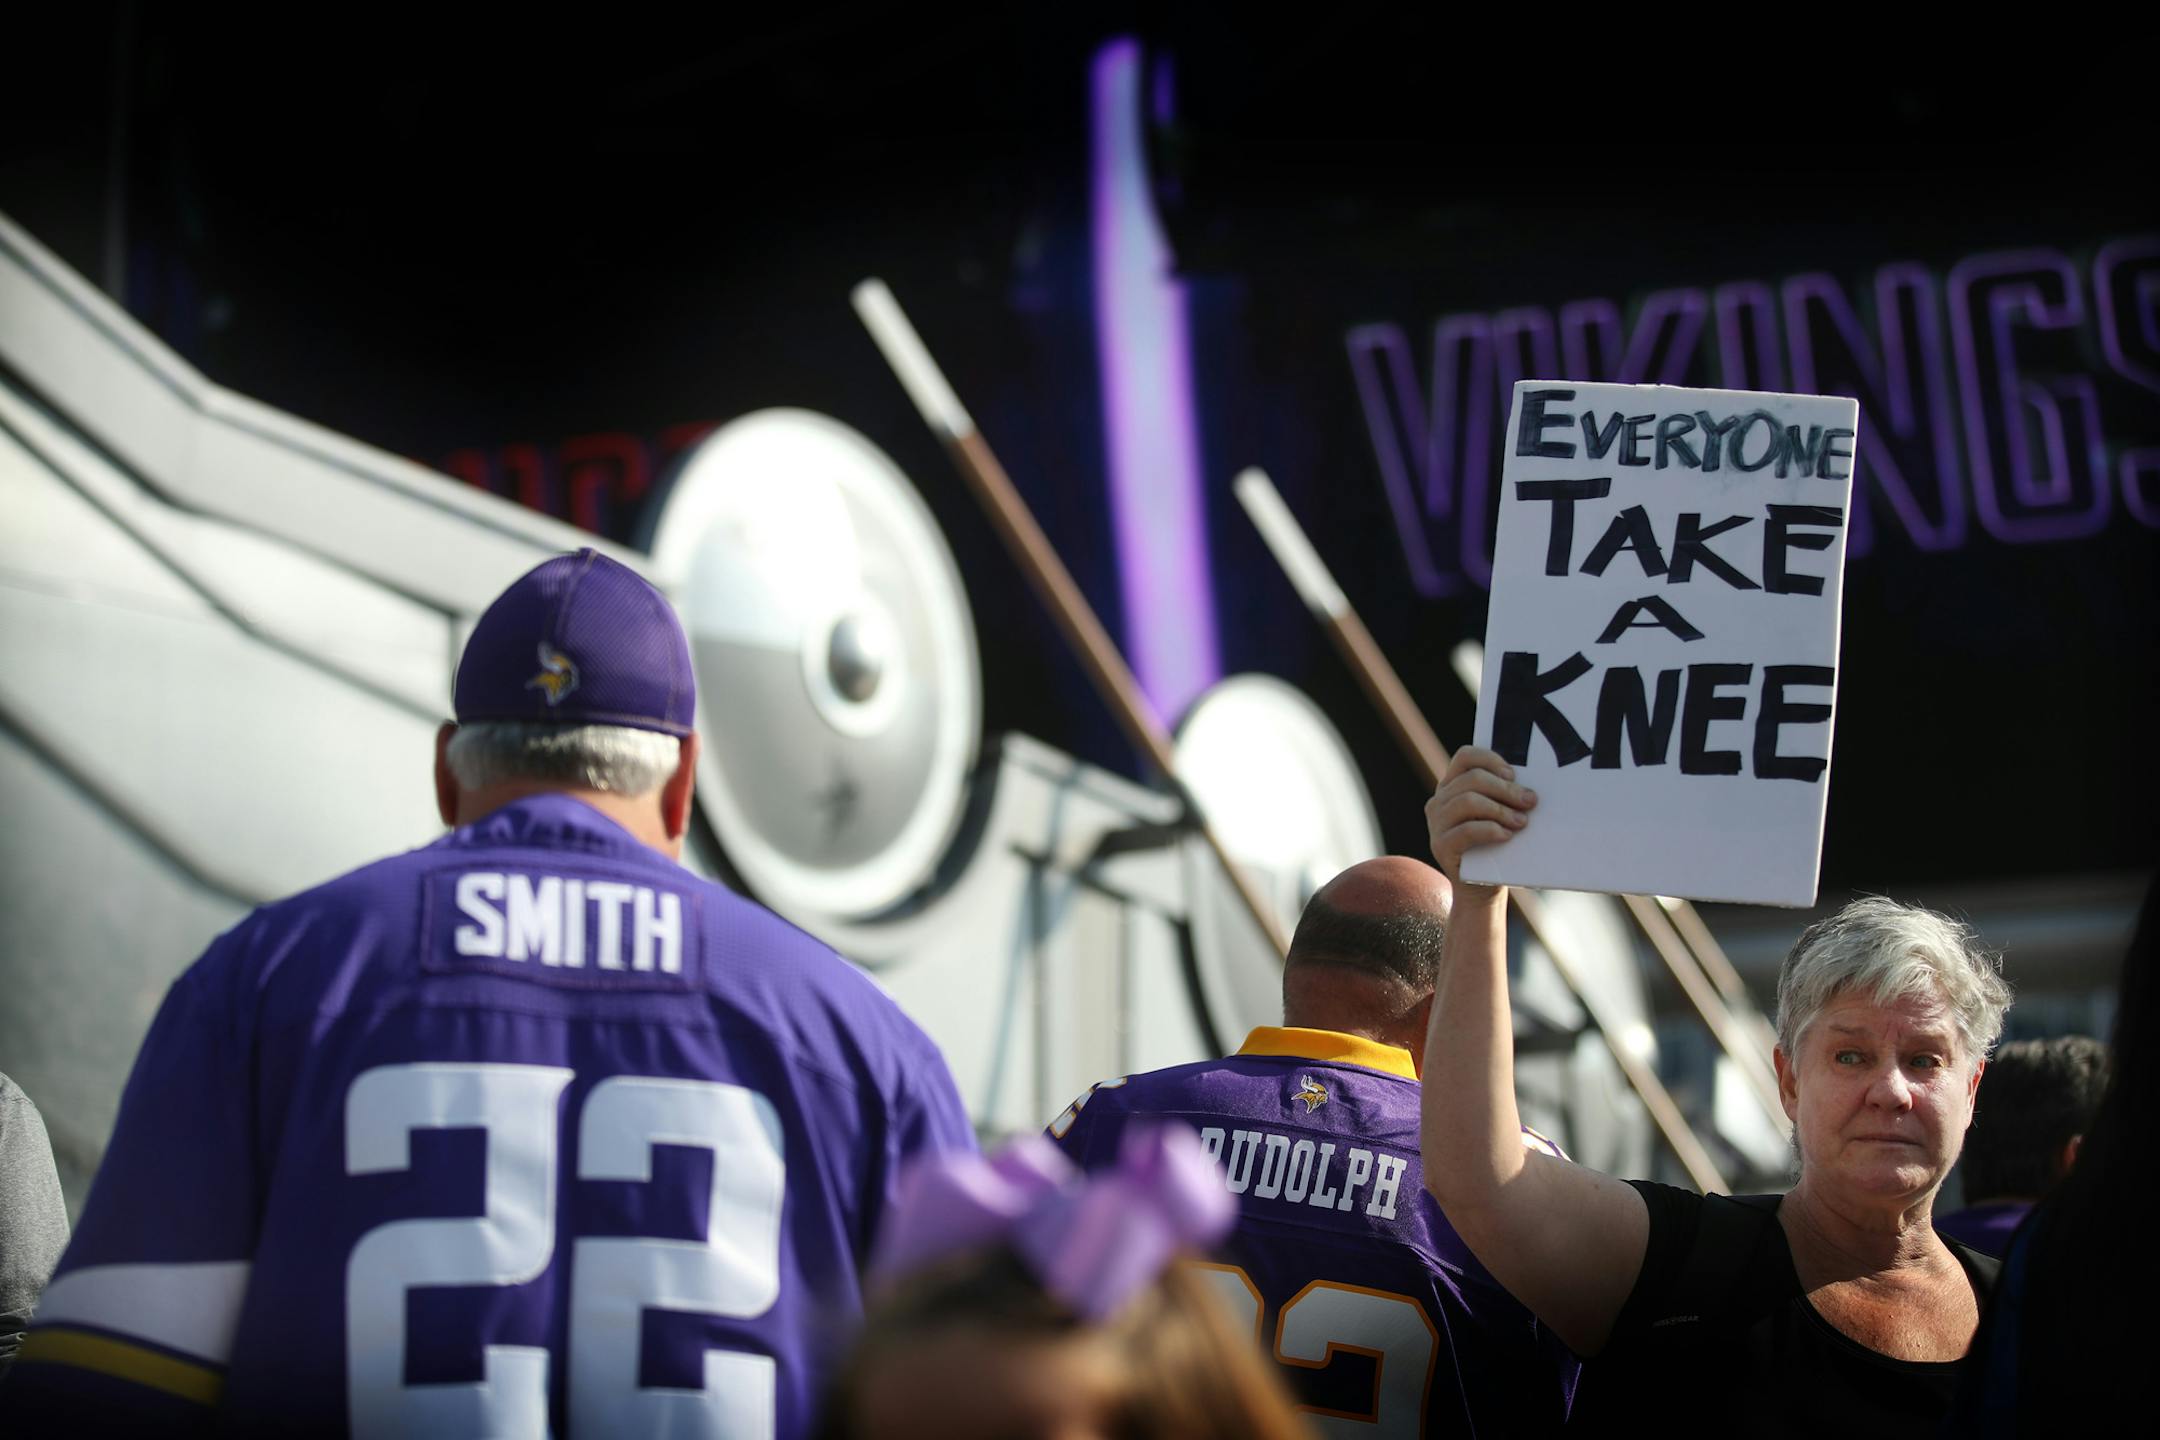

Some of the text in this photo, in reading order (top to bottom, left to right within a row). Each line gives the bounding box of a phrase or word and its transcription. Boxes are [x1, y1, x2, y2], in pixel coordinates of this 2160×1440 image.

[1515, 389, 1855, 480] EVERYONE
[1515, 477, 1843, 596] TAKE
[1595, 595, 1706, 644] A
[1491, 651, 1836, 783] KNEE
[454, 871, 683, 974] SMITH
[345, 1061, 787, 1440] 22
